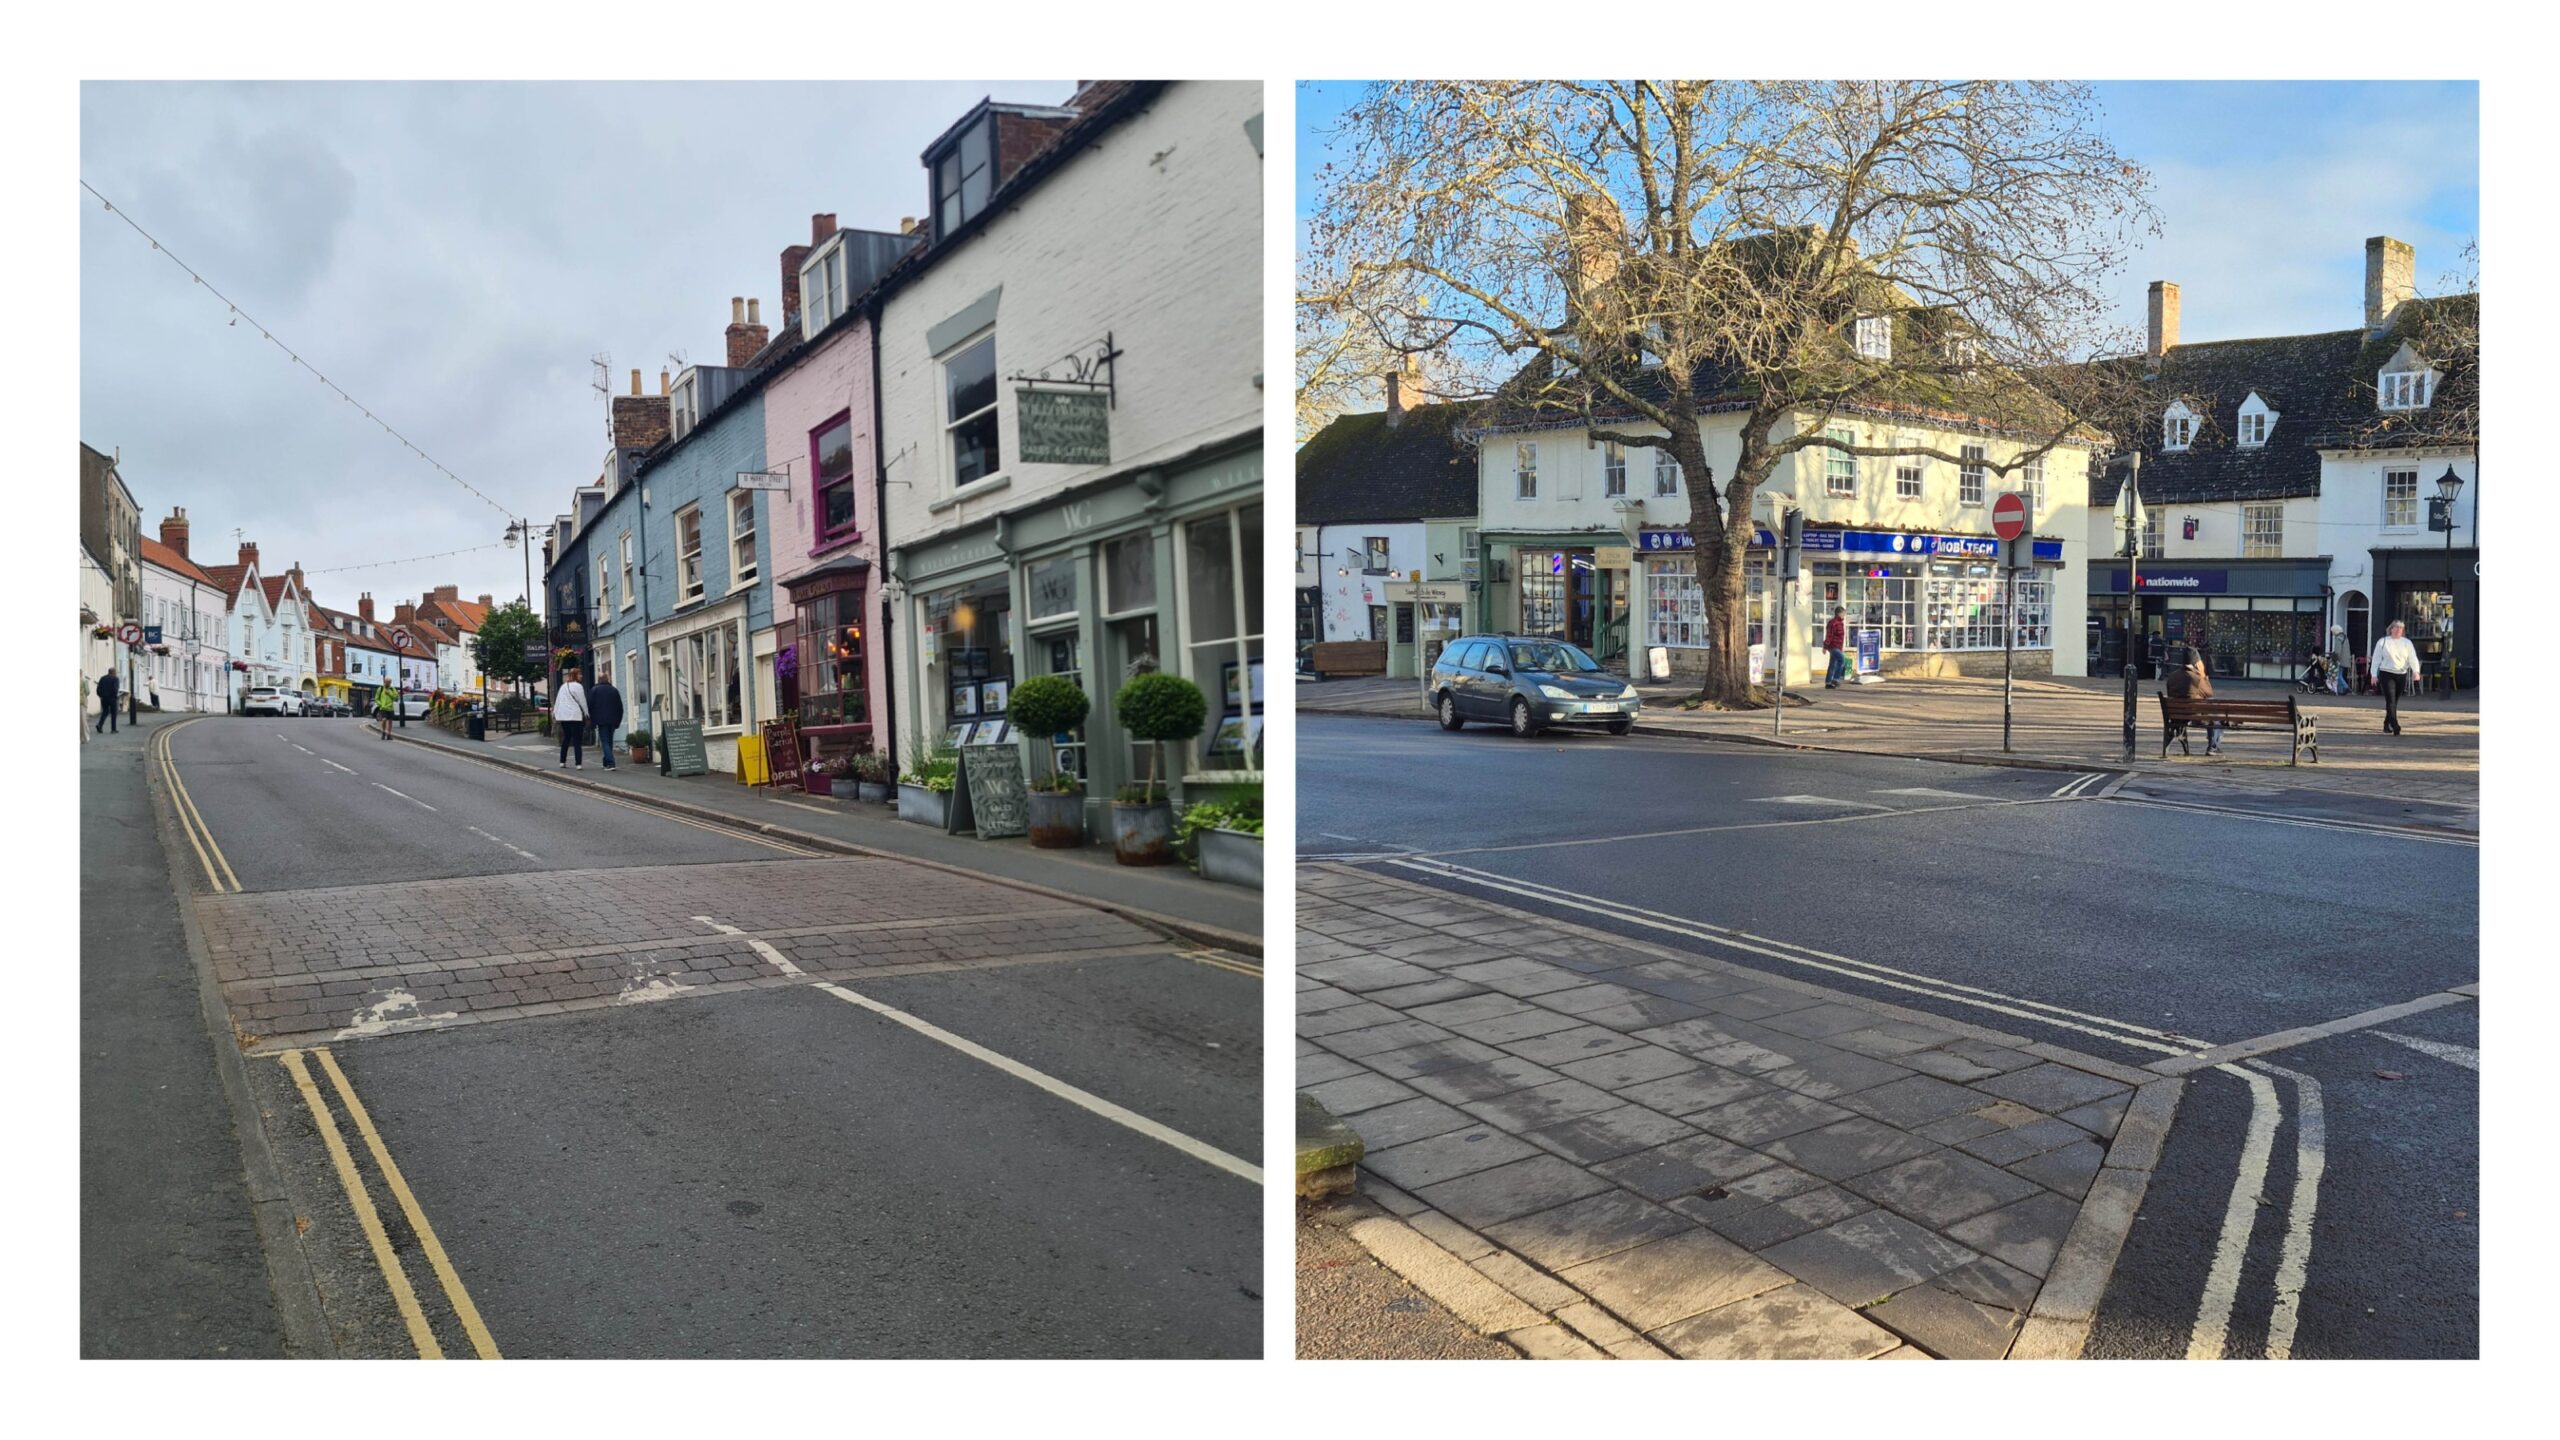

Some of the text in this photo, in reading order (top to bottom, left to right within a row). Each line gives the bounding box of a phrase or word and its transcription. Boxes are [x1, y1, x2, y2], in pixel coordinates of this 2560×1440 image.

[2145, 576, 2200, 587] nationwide
[771, 770, 798, 781] OPEN
[984, 779, 1011, 796] WG
